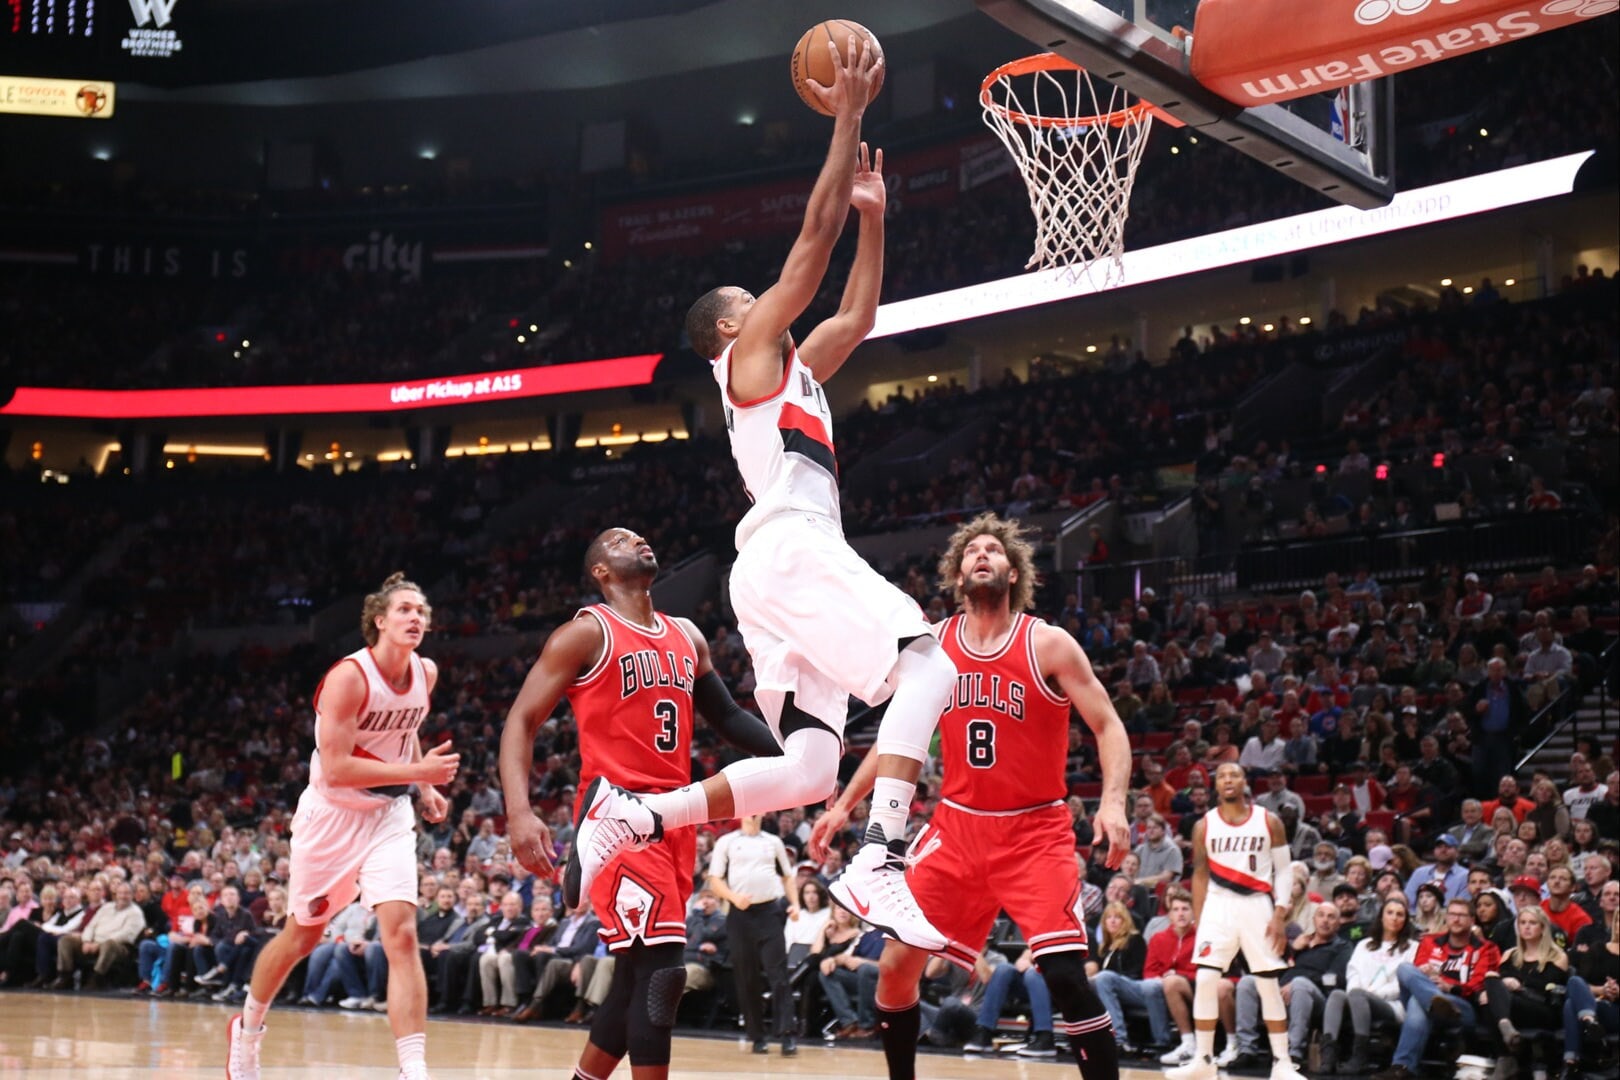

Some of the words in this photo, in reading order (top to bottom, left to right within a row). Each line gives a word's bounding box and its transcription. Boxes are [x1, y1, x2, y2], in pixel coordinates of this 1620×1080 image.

[121, 38, 182, 51] BROTHERS
[19, 86, 66, 97] TOYOTA
[391, 386, 425, 403] Uber
[426, 380, 473, 399] Pickup
[474, 377, 490, 394] at
[619, 649, 695, 700] BULLS
[654, 699, 678, 753] 3
[966, 719, 996, 769] 8
[1210, 836, 1265, 853] BLAZERS
[1248, 854, 1257, 872] 0
